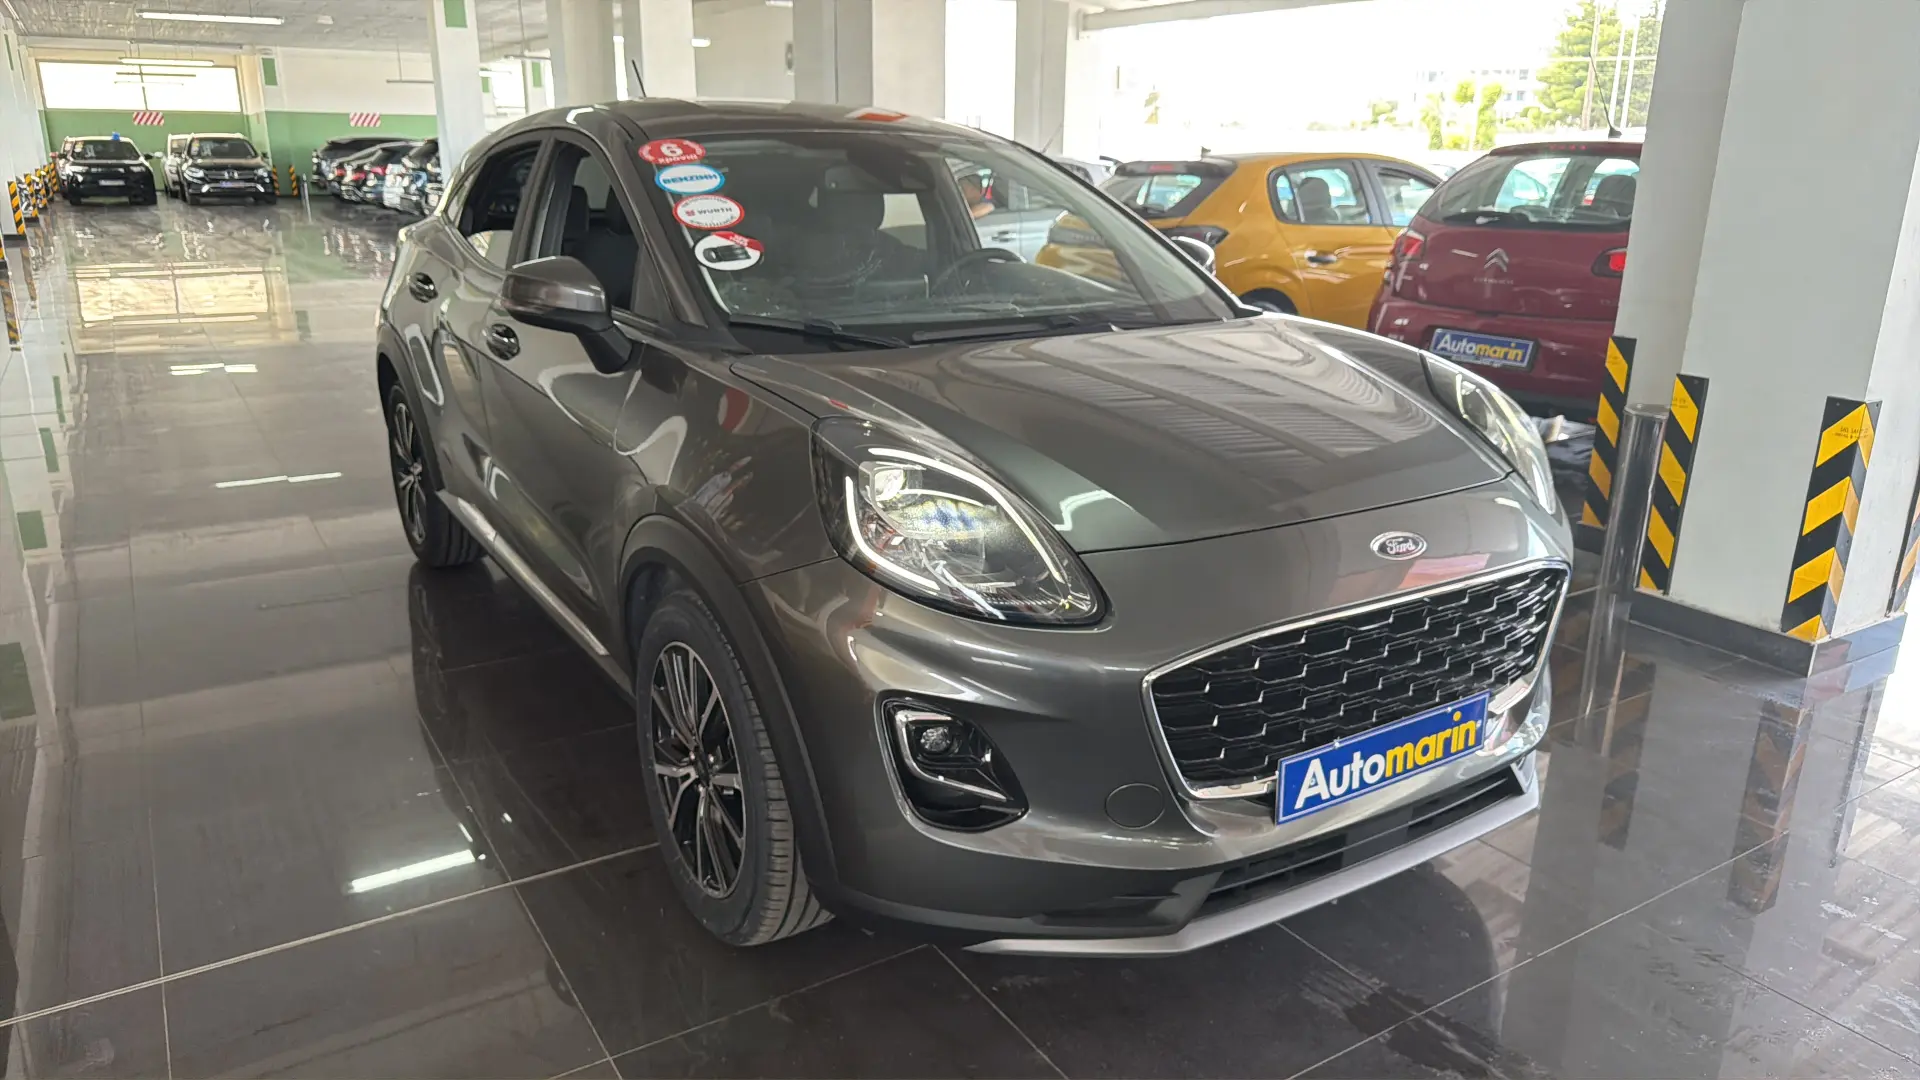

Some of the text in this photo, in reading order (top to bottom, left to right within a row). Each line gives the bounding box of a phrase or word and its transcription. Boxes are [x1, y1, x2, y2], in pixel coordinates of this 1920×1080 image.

[660, 143, 683, 157] 6
[1436, 333, 1523, 361] Automarin
[1385, 537, 1416, 555] Ford
[1294, 711, 1477, 810] Automarin
